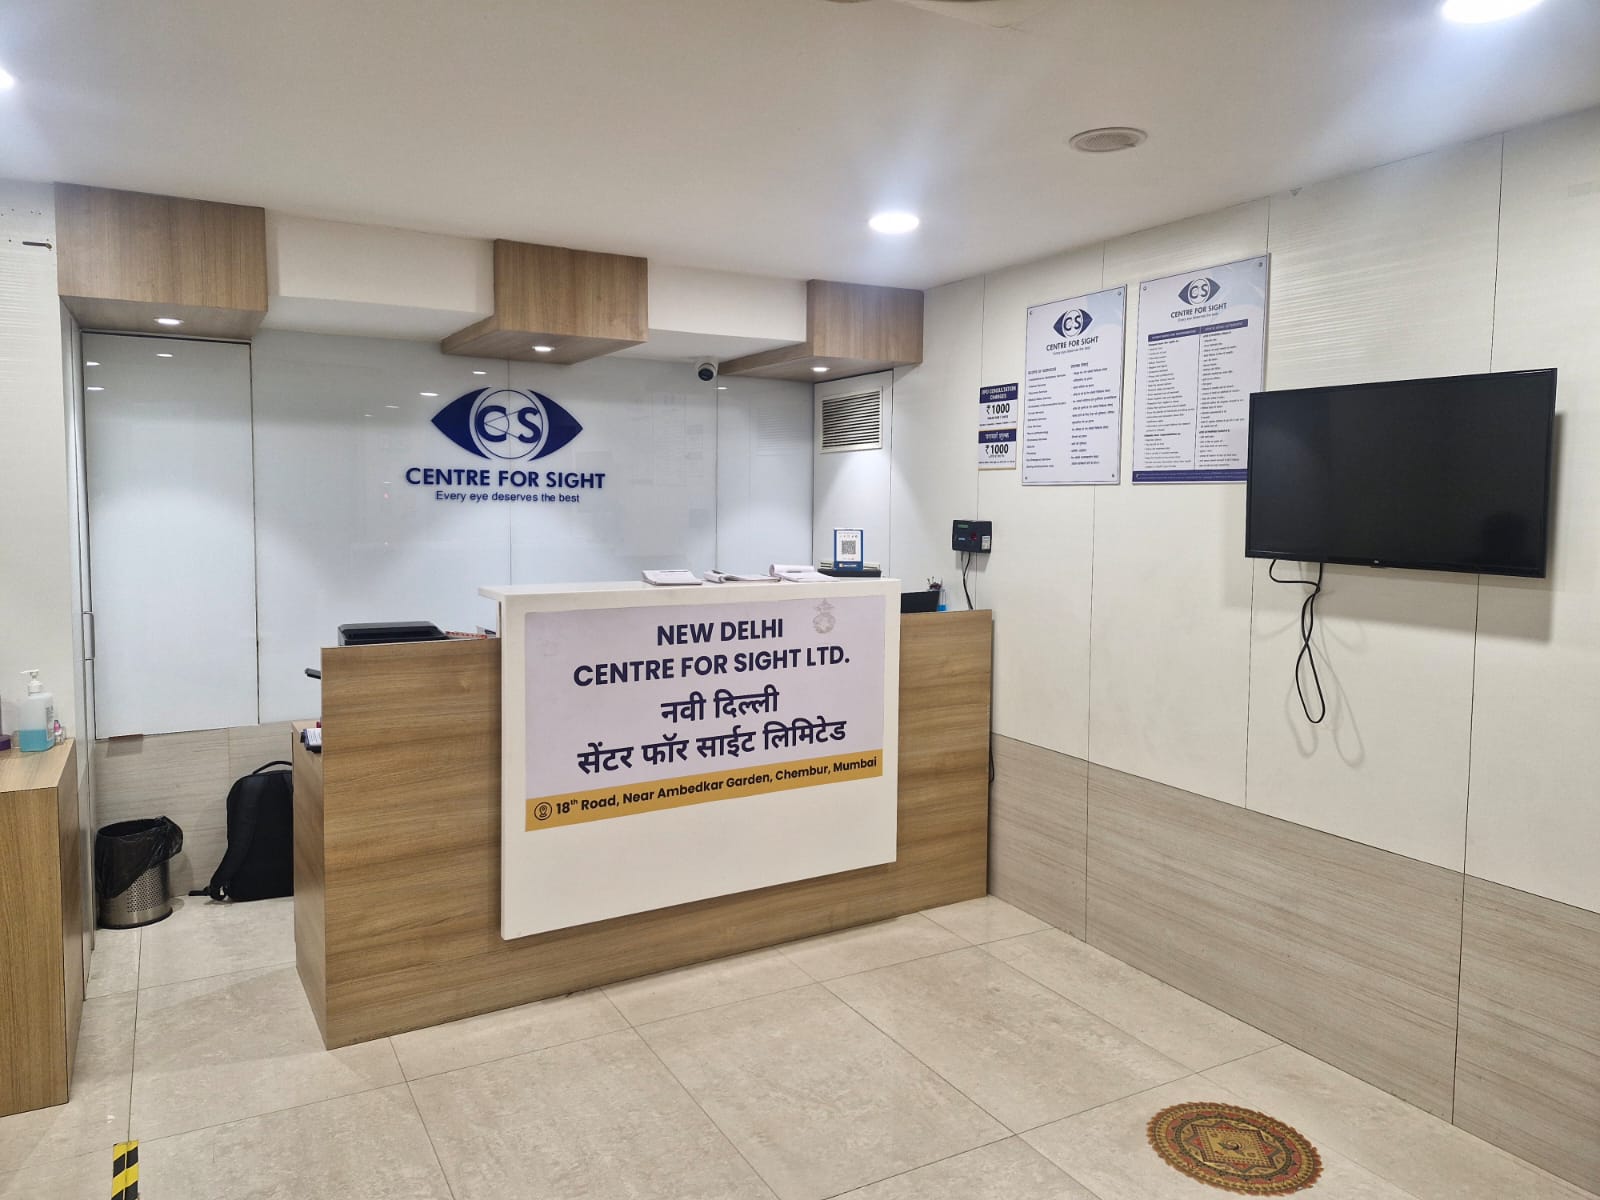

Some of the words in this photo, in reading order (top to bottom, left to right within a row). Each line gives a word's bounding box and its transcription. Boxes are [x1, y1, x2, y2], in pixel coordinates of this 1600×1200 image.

[1170, 308, 1193, 319] CENTRE
[1194, 305, 1207, 314] FOR
[1208, 302, 1227, 313] SIGHT
[1046, 341, 1067, 352] CENTRE
[1068, 339, 1080, 348] FOR
[1081, 336, 1099, 346] SIGHT
[474, 405, 542, 444] CS
[405, 467, 490, 486] CENTRE
[498, 470, 540, 487] FOR
[546, 471, 606, 489] SIGHT
[436, 491, 466, 503] Every
[469, 493, 488, 503] eye
[491, 491, 538, 502] deserves
[541, 492, 556, 502] the
[559, 493, 580, 503] best
[656, 622, 714, 646] NEW
[720, 618, 784, 642] DELHI
[573, 658, 675, 687] CENTRE
[681, 654, 728, 678] FOR
[733, 648, 801, 673] SIGHT
[806, 645, 850, 667] LTD.
[660, 691, 707, 723] नवी
[713, 684, 780, 719] दिल्ली
[577, 741, 634, 775] सेंटर
[642, 733, 689, 765] फॉर
[696, 725, 756, 758] साईट
[763, 715, 847, 750] लिमिटेड
[556, 799, 578, 815] 18th
[581, 794, 620, 811] Road,
[622, 790, 655, 805] Near
[657, 780, 724, 799] Ambedkar
[726, 772, 773, 789] Garden,
[775, 764, 831, 781] Chembur,
[833, 756, 877, 773] Mumbai
